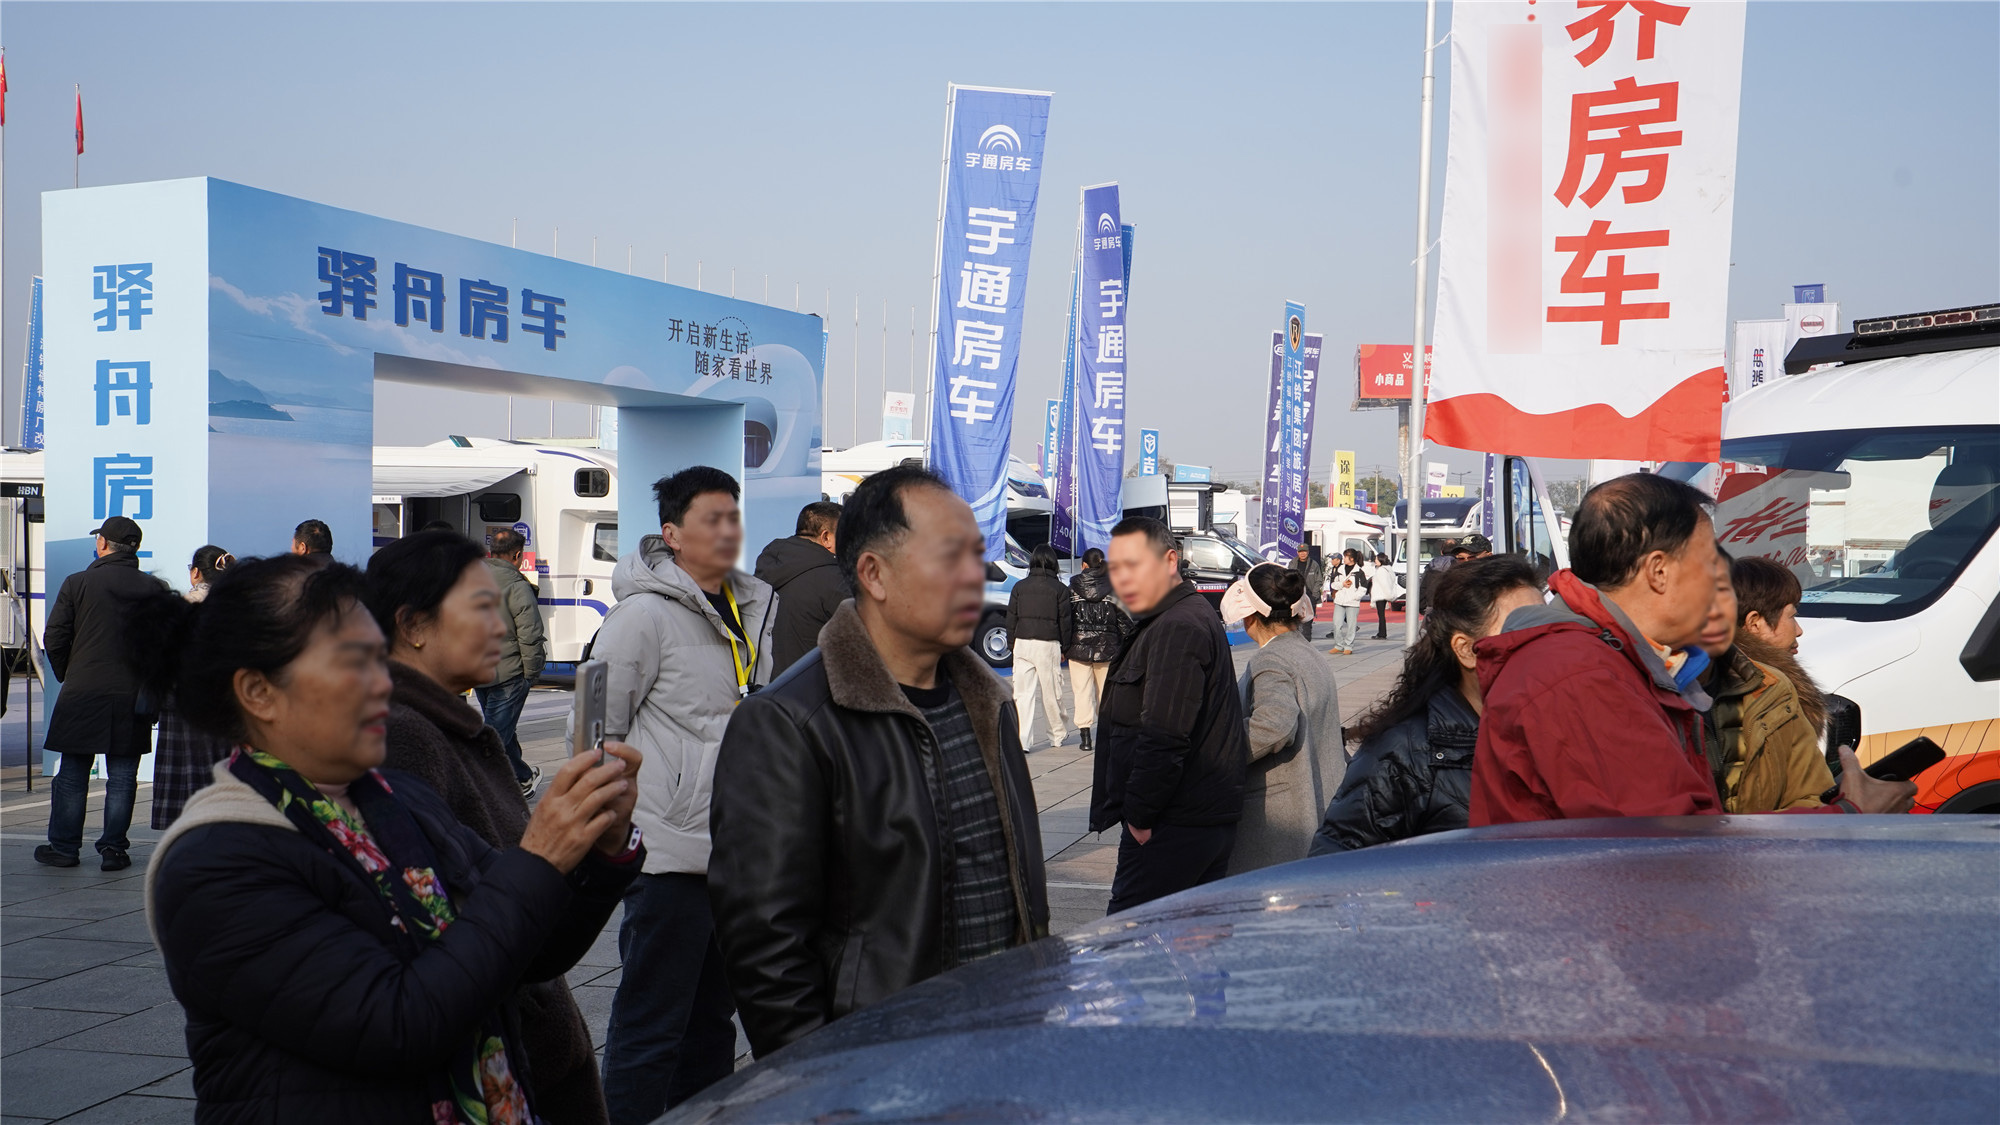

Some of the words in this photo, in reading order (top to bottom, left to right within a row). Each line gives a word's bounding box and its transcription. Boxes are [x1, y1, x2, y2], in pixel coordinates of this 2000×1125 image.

[966, 152, 1032, 172] 宇通房车
[1094, 235, 1121, 251] 宇通房车
[317, 246, 567, 352] 驿舟房车
[949, 206, 1017, 425] 宇通房车
[668, 318, 750, 355] 开启新生活
[694, 350, 773, 385] 随家看世界
[1091, 278, 1124, 455] 宇通房车
[1402, 351, 1432, 364] 义购
[1375, 372, 1404, 386] 小商品
[1143, 456, 1156, 475] 吉
[17, 486, 39, 496] HBN
